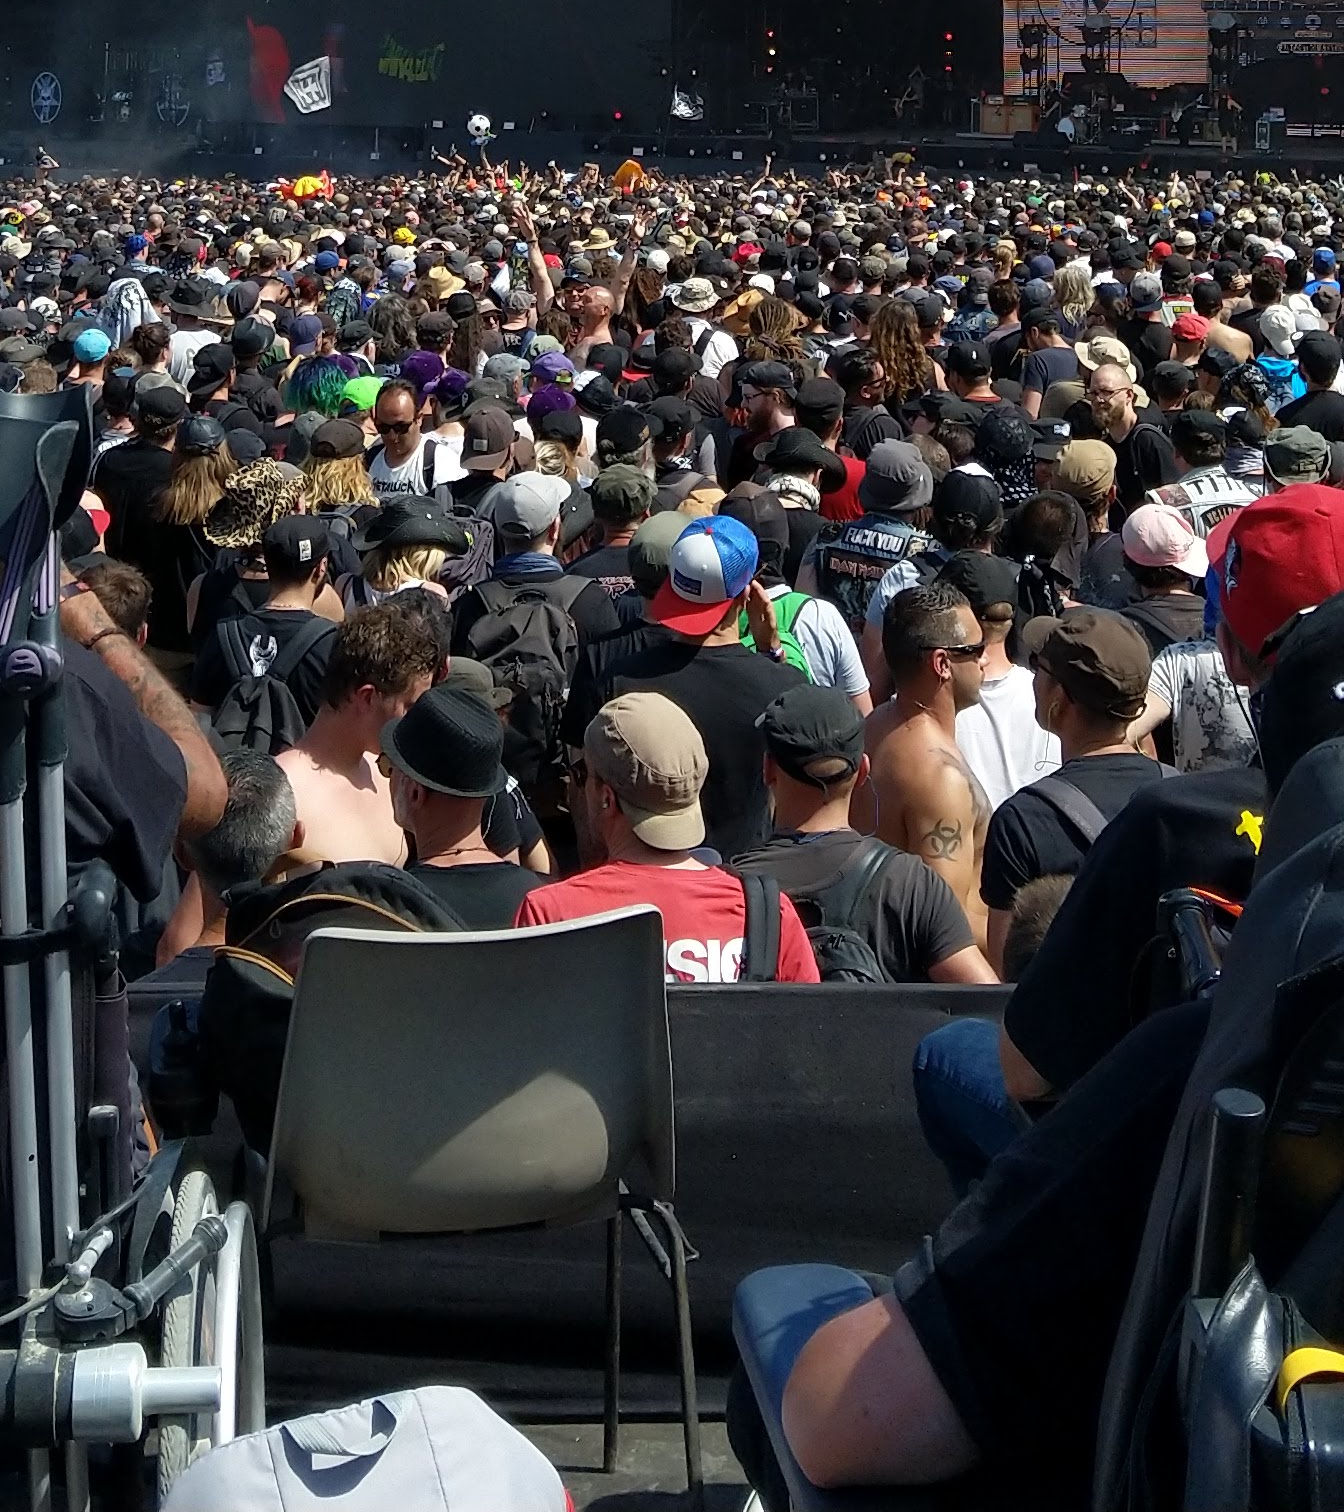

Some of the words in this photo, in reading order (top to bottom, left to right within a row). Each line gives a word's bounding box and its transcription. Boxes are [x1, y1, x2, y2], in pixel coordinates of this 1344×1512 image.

[845, 528, 877, 547] FUCK
[877, 533, 904, 553] YOU
[858, 563, 885, 580] MAID
